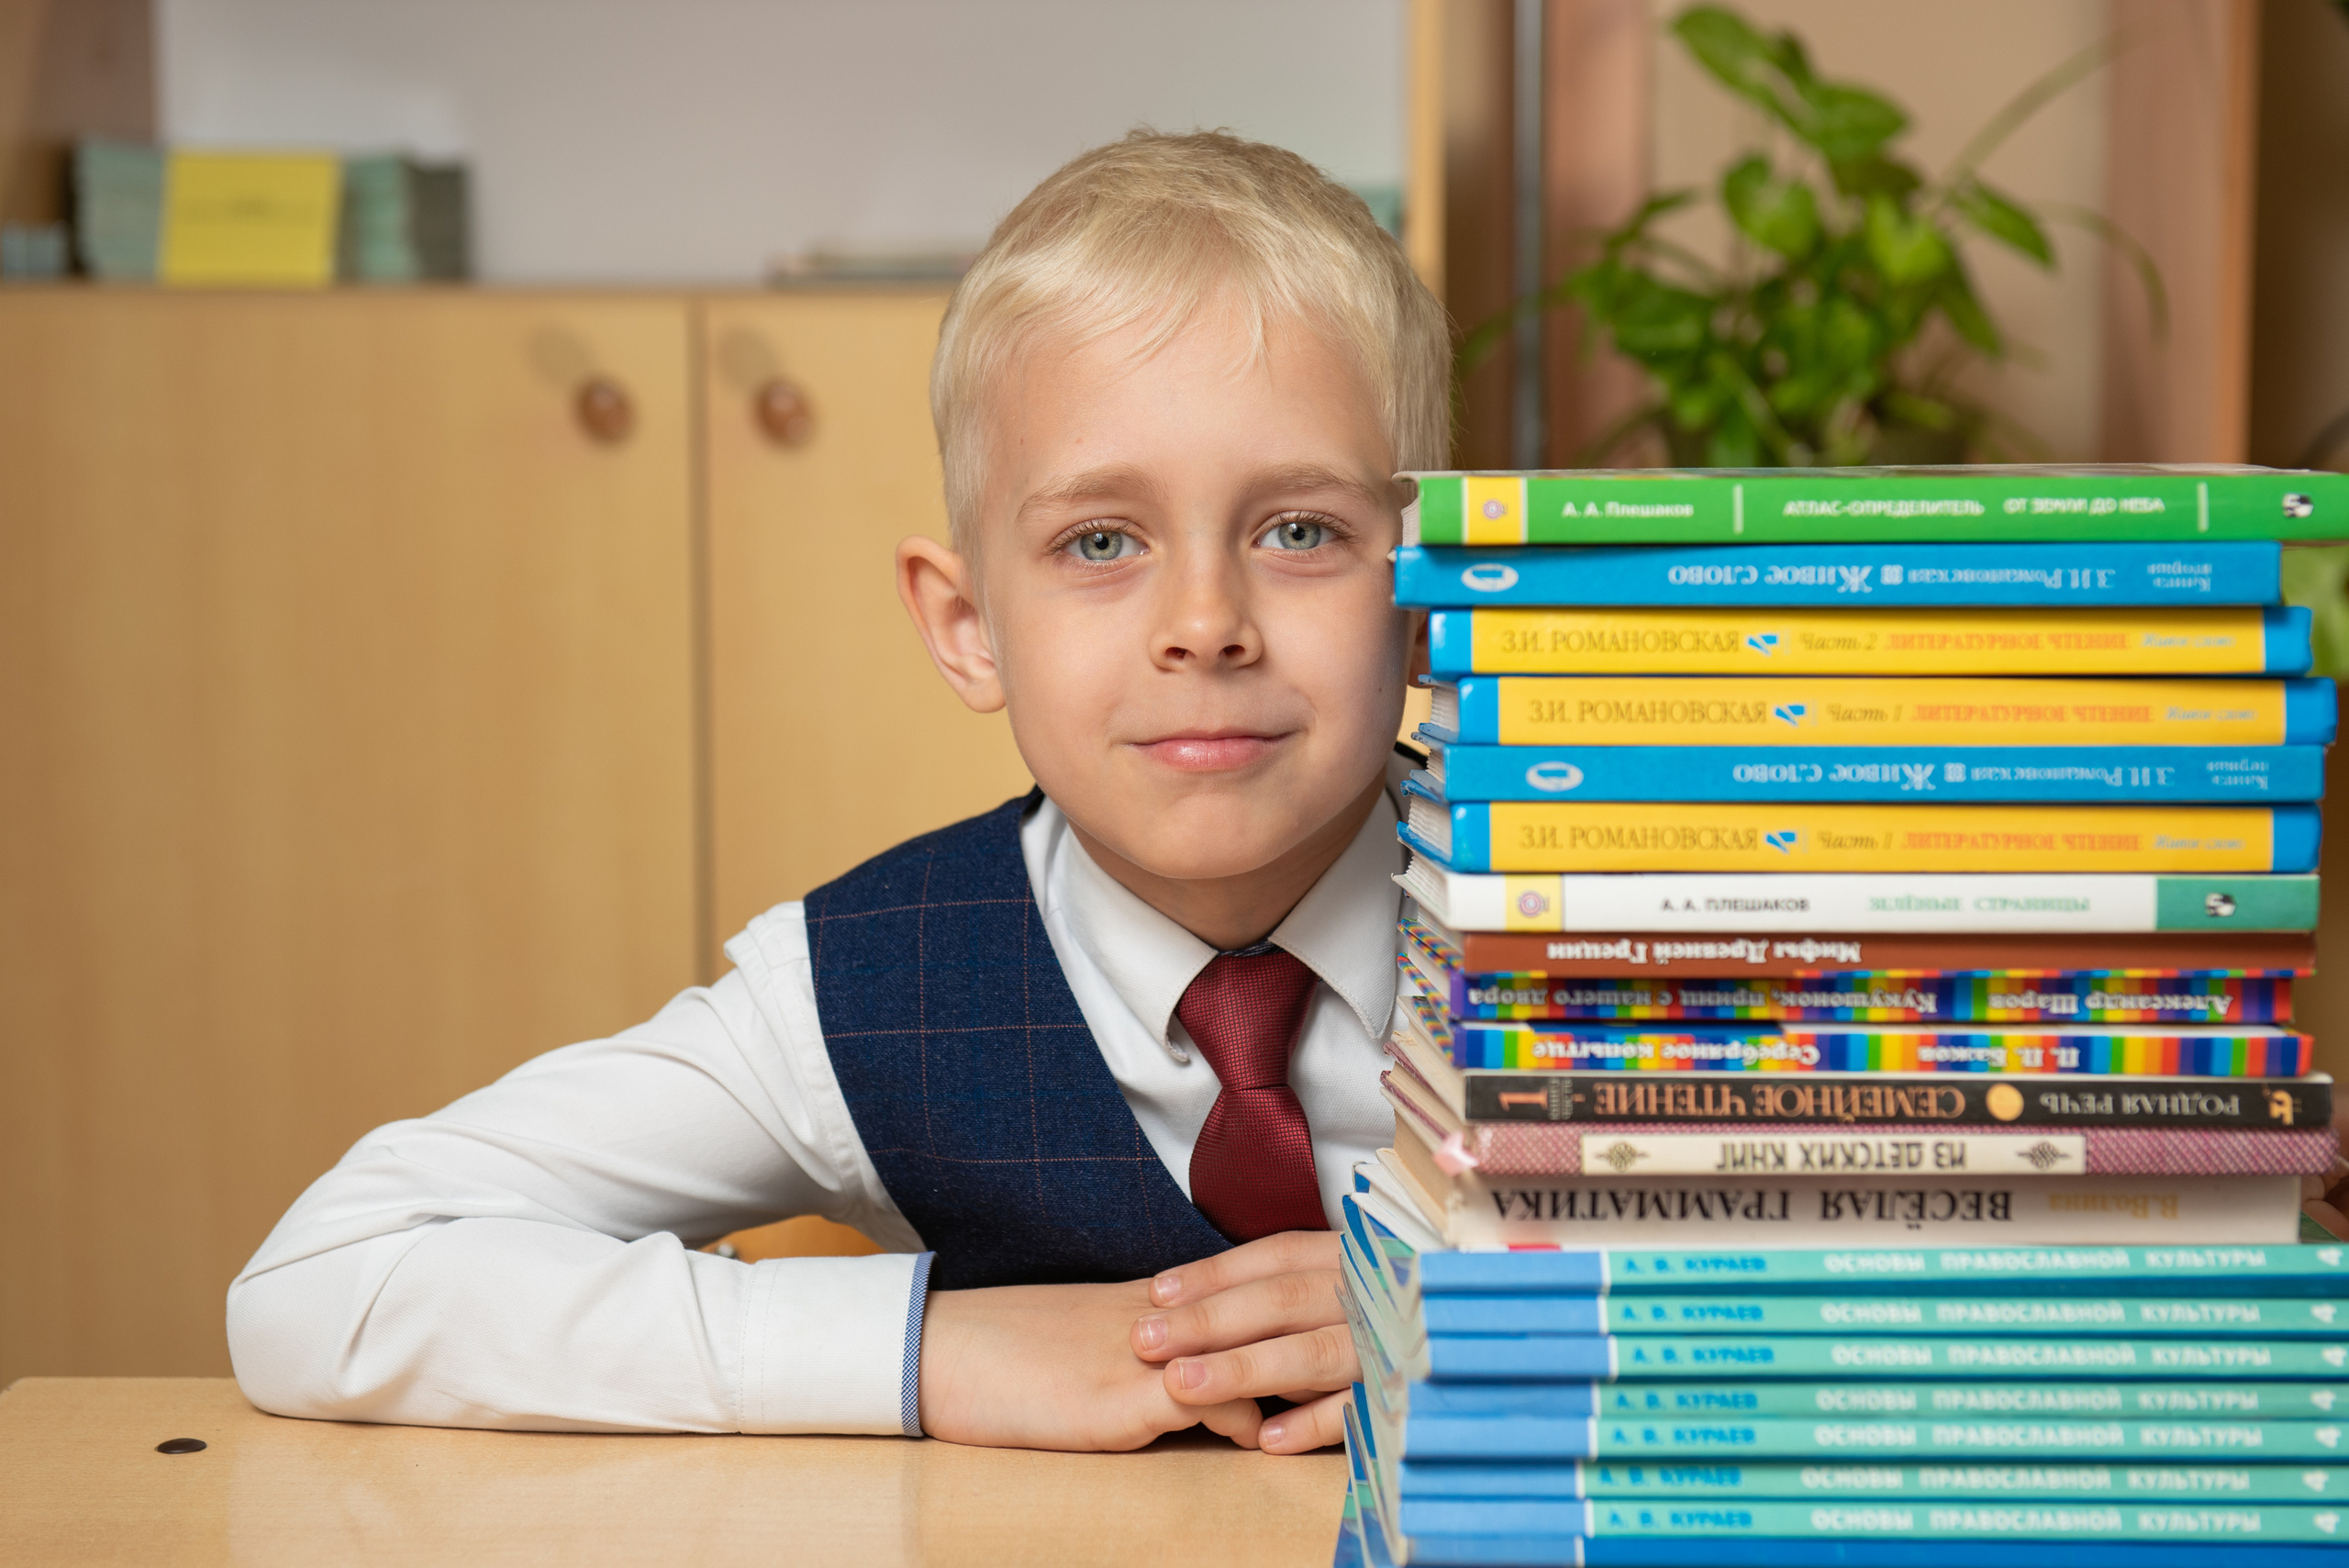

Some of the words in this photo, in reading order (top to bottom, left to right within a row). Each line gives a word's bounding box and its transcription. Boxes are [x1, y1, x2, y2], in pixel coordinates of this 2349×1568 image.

[1562, 501, 1581, 518] А.
[1584, 501, 1603, 518] А.
[1605, 501, 1695, 519] Плешаков
[1783, 499, 1985, 517] АТЛАС-ОПРЕДЕЛИТЕЛЬ
[2002, 497, 2028, 515] ОТ
[2030, 497, 2087, 515] ЗЕМЛИ
[2087, 497, 2117, 516] ДО
[2118, 496, 2165, 514] НЕБА
[1667, 565, 1759, 585] слово
[1764, 565, 1873, 594] Живое
[1907, 567, 2063, 590] Романовская
[2146, 561, 2212, 577] вторая
[2153, 577, 2211, 593] Книга
[1551, 630, 1740, 654] РОМАНОВСКАЯ
[1798, 632, 1861, 651] Часть
[1864, 633, 1878, 651] 2
[1886, 633, 2043, 651] ЛИТЕРАТУРНОЕ
[2046, 633, 2131, 651] ЧТЕНИЕ
[1578, 699, 1767, 724] РОМАНОВСКАЯ
[1827, 703, 1888, 722] Часть
[1892, 705, 1903, 722] 1
[1909, 705, 2068, 723] ЛИТЕРАТУРНОЕ
[2072, 705, 2154, 723] ЧТЕНИЕ
[1732, 762, 1823, 783] слово
[1829, 762, 1936, 791] Живое
[1970, 766, 2123, 787] Романовская
[2206, 758, 2269, 773] первая
[2211, 774, 2268, 790] Книга
[1570, 825, 1758, 851] РОМАНОВСКАЯ
[1817, 830, 1878, 850] Часть
[1882, 832, 1893, 850] 1
[1899, 832, 2060, 851] ЛИТЕРАТУРНОЕ
[2062, 833, 2143, 851] ЧТЕНИЕ
[1662, 897, 1678, 912] А.
[1684, 897, 1701, 912] А.
[1705, 897, 1810, 913] ПЛЕШАКОВ
[1974, 895, 2090, 913] СТРАНИЦЫ
[1546, 939, 1648, 964] Греции
[1653, 939, 1769, 965] Древней
[1773, 939, 1862, 963] Мифы
[1468, 985, 1548, 1006] двора
[1553, 988, 1652, 1006] нашего
[1658, 990, 1673, 1006] с
[1678, 986, 1766, 1006] принц
[1771, 987, 1938, 1013] Кукушонок,
[1988, 993, 2079, 1015] Шаров
[2085, 990, 2233, 1016] Александр
[1533, 1040, 1654, 1059] копытце
[1662, 1040, 1820, 1066] Серебряное
[1918, 1045, 2008, 1068] Бажов
[2015, 1046, 2044, 1068] П.
[2050, 1046, 2079, 1068] П.
[1498, 1087, 1548, 1112] 1
[1593, 1082, 1747, 1116] ЧТЕНИЕ
[1752, 1084, 1965, 1123] СЕМЕЙНОЕ
[2040, 1092, 2113, 1115] РЕЧЬ
[2121, 1093, 2241, 1117] РОДНАЯ
[1716, 1142, 1788, 1169] КНИГ
[1798, 1142, 1924, 1169] ДЕТСКИХ
[1934, 1142, 1968, 1169] ИЗ
[1493, 1189, 1792, 1222] ГРАММАТИКА
[1820, 1189, 2013, 1230] ВЕСЁЛАЯ
[1625, 1257, 1643, 1273] А.
[1683, 1257, 1768, 1273] КУРАЕВ
[1823, 1252, 1925, 1273] ОСНОВЫ
[1940, 1249, 2131, 1272] ПРАВОСЛАВНОЙ
[2144, 1249, 2266, 1268] КУЛЬТУРЫ
[2316, 1247, 2343, 1267] 4
[1622, 1305, 1642, 1322] А.
[1681, 1305, 1765, 1322] КУРАЕВ
[1820, 1303, 1922, 1323] ОСНОВЫ
[1936, 1300, 2125, 1323] ПРАВОСЛАВНОЙ
[2140, 1304, 2261, 1323] КУЛЬТУРЫ
[2310, 1303, 2337, 1323] 4
[1633, 1346, 1652, 1363] А.
[1692, 1346, 1776, 1363] КУРАЕВ
[1831, 1344, 1932, 1365] ОСНОВЫ
[1947, 1342, 2136, 1365] ПРАВОСЛАВНОЙ
[2151, 1346, 2271, 1366] КУЛЬТУРЫ
[2321, 1346, 2347, 1367] 4
[1615, 1392, 1634, 1410] А.
[1675, 1392, 1758, 1410] КУРАЕВ
[1815, 1389, 1917, 1411] ОСНОВЫ
[1932, 1387, 2122, 1411] ПРАВОСЛАВНОЙ
[2138, 1390, 2259, 1410] КУЛЬТУРЫ
[2310, 1390, 2336, 1411] 4
[1612, 1428, 1631, 1445] А.
[1673, 1428, 1756, 1445] КУРАЕВ
[1813, 1425, 1916, 1447] ОСНОВЫ
[1932, 1422, 2124, 1447] ПРАВОСЛАВНОЙ
[2140, 1426, 2263, 1447] КУЛЬТУРЫ
[2314, 1425, 2341, 1448] 4
[1599, 1467, 1619, 1485] А.
[1658, 1466, 1742, 1485] КУРАЕВ
[1800, 1468, 1903, 1489] ОСНОВЫ
[1918, 1466, 2110, 1490] ПРАВОСЛАВНОЙ
[2126, 1469, 2250, 1490] КУЛЬТУРЫ
[2303, 1469, 2329, 1492] 4
[1609, 1510, 1628, 1529] А.
[1670, 1510, 1753, 1529] КУРАЕВ
[1810, 1509, 1913, 1530] ОСНОВЫ
[1929, 1507, 2121, 1531] ПРАВОСЛАВНОЙ
[2137, 1510, 2261, 1532] КУЛЬТУРЫ
[2313, 1511, 2340, 1533] 4
